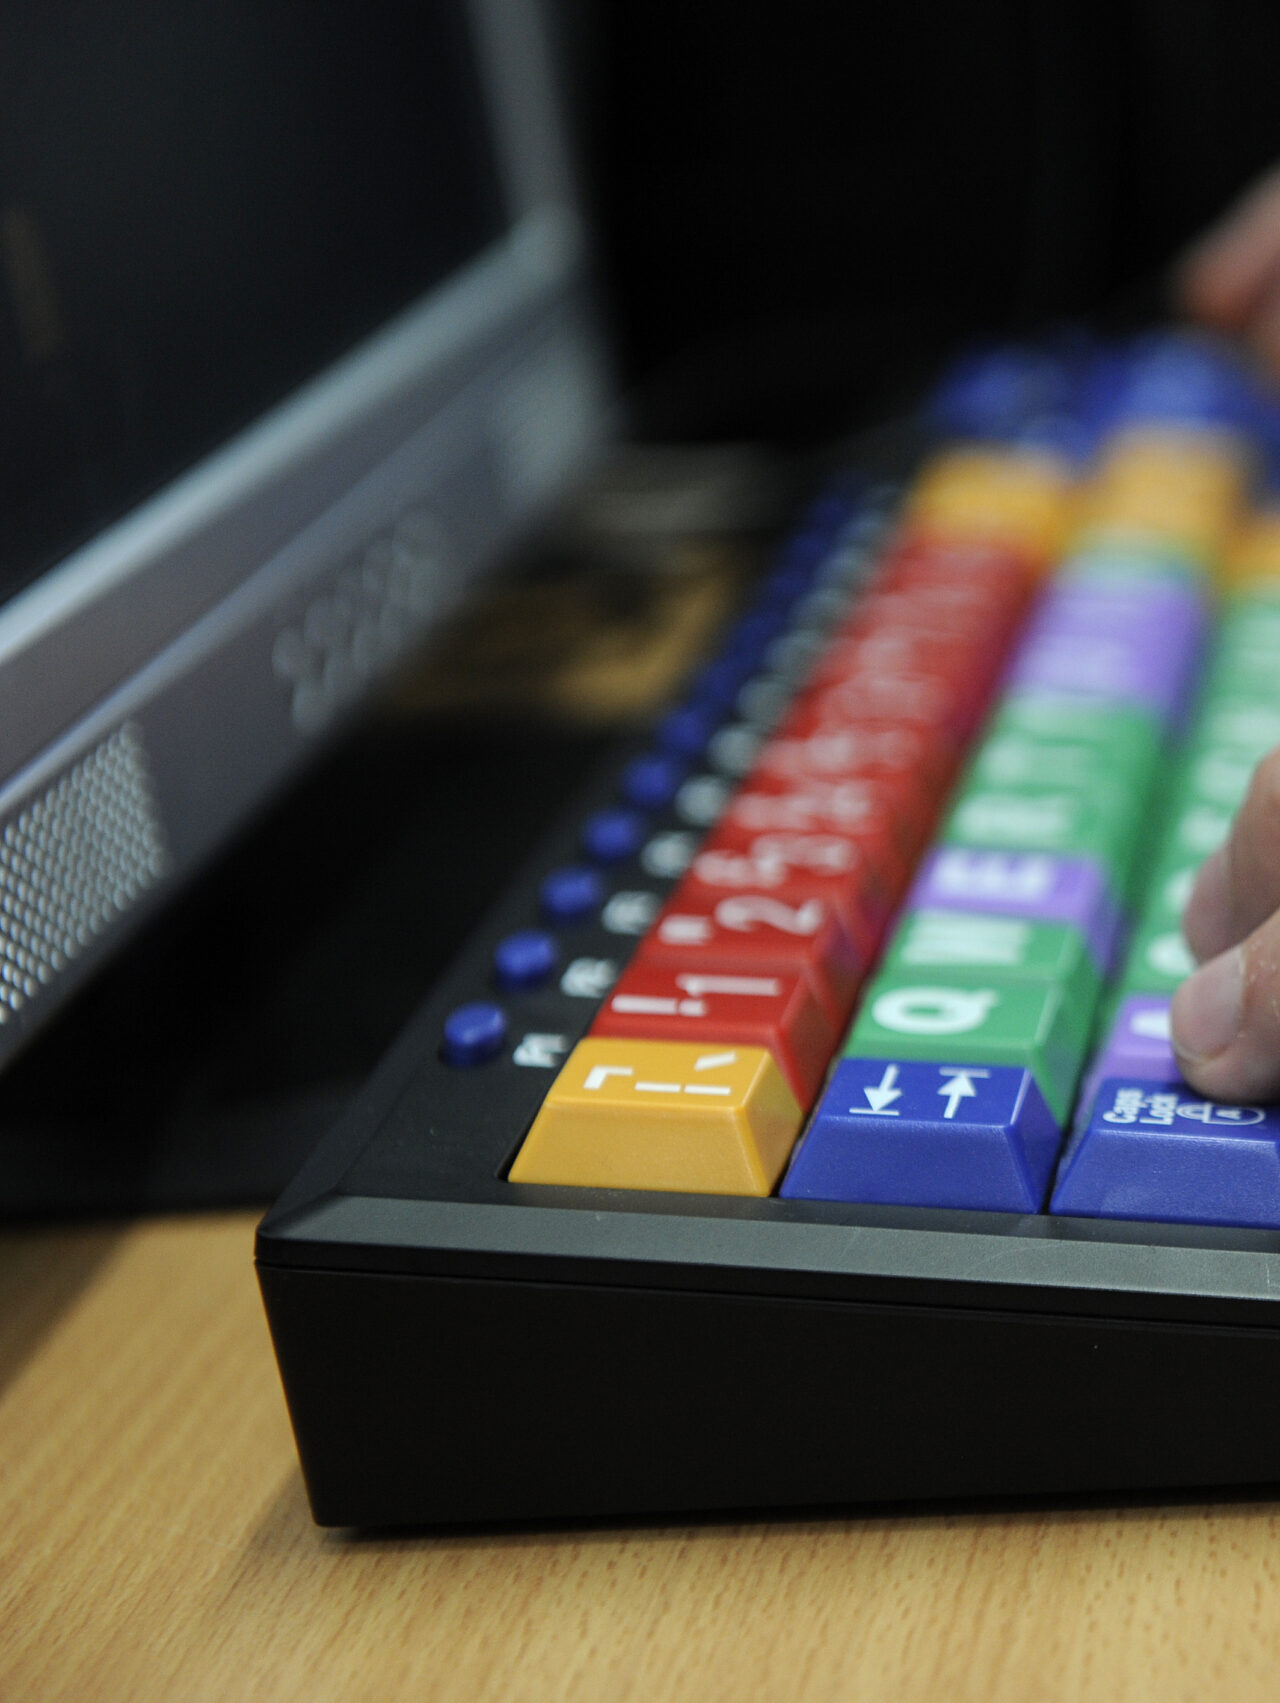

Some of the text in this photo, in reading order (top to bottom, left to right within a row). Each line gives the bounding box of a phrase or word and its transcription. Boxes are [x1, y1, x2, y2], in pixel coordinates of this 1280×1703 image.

[928, 850, 1047, 900] E
[715, 895, 822, 935] 2
[676, 973, 781, 996] 1
[871, 985, 998, 1035] Q
[1102, 1089, 1148, 1124] Caps
[1139, 1093, 1179, 1125] Lock
